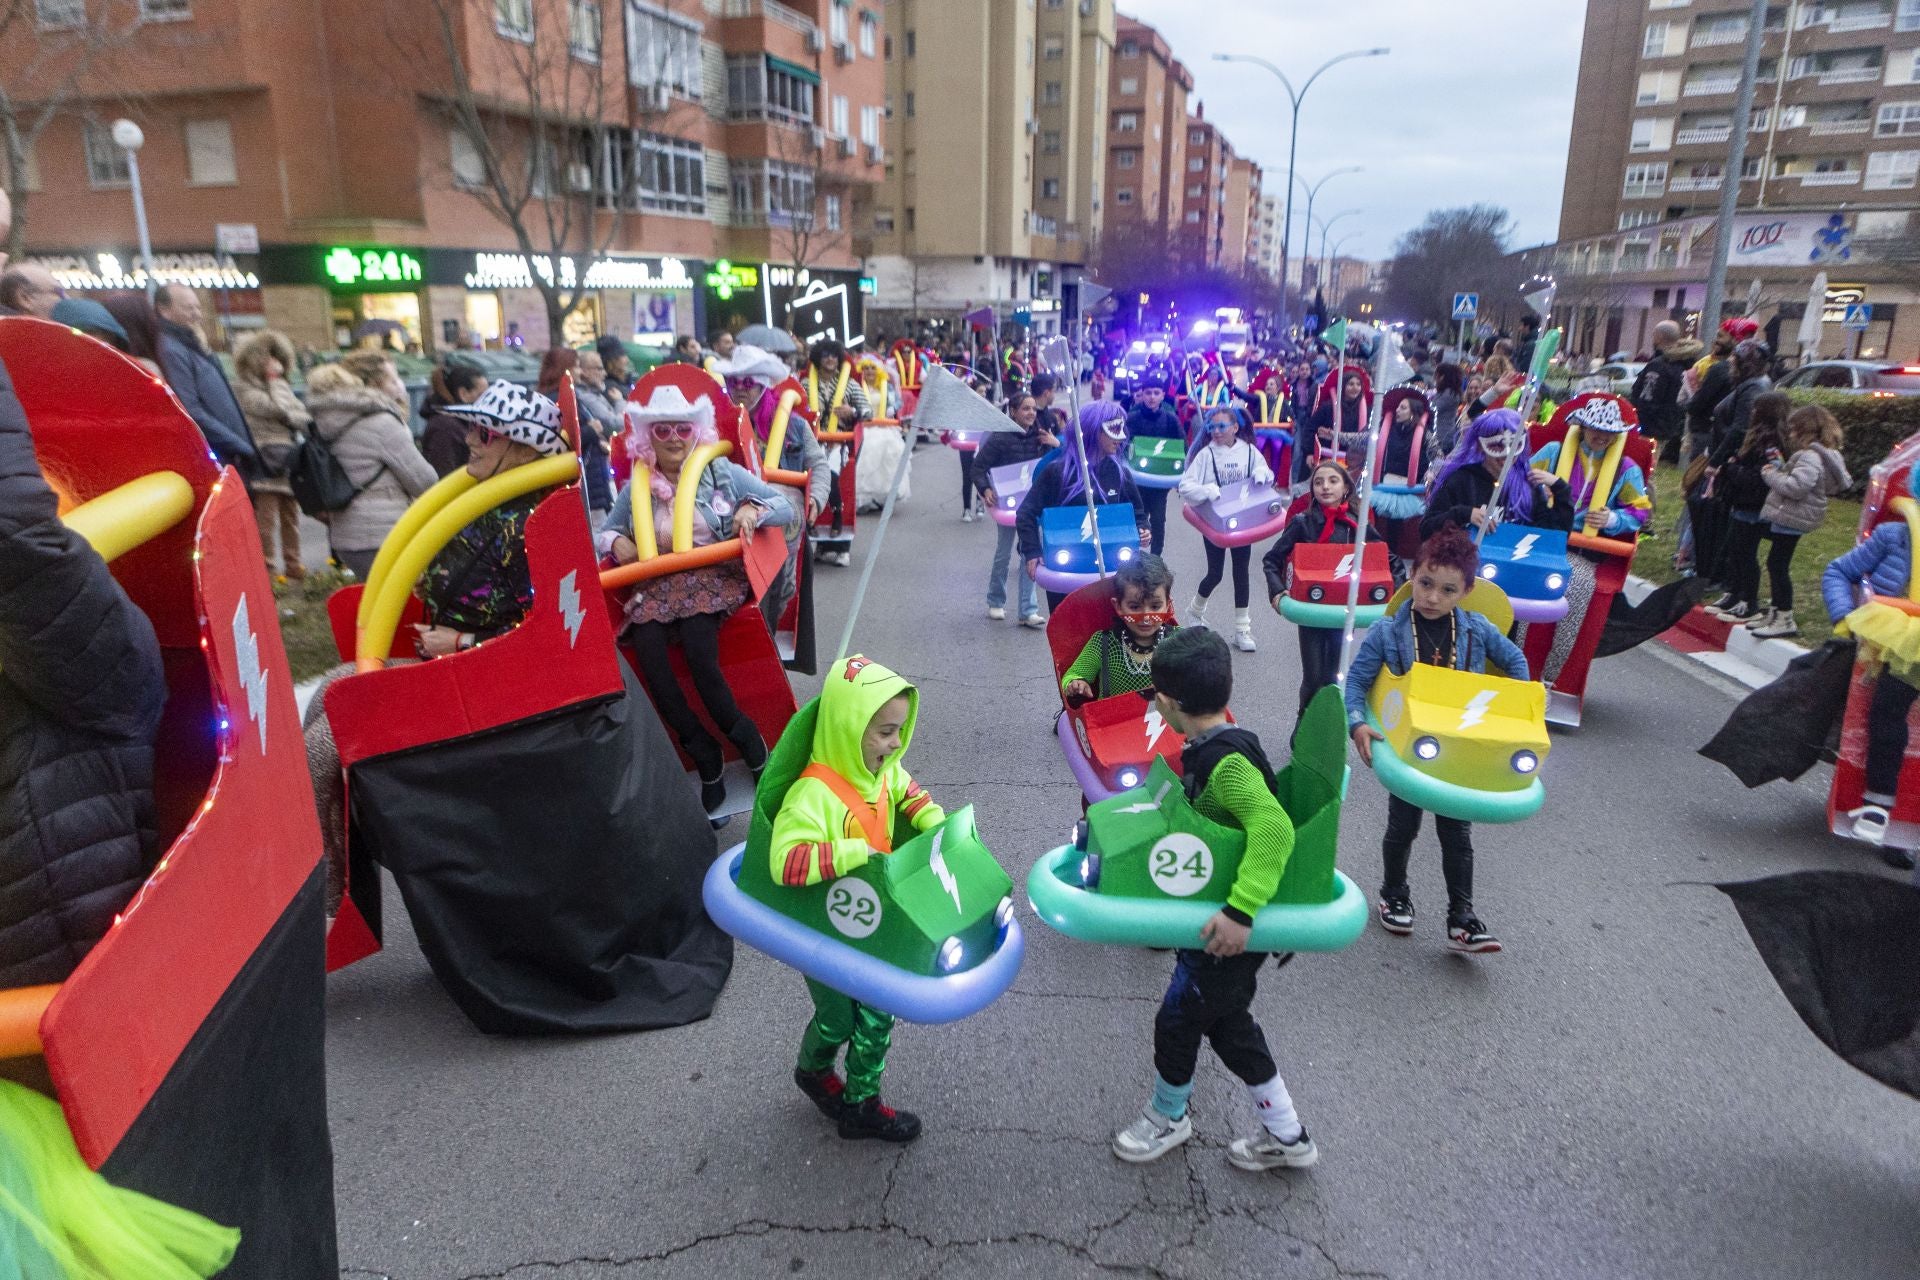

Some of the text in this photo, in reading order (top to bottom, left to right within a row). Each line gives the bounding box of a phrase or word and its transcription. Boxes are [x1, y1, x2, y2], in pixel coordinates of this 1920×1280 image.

[1741, 220, 1787, 249] 100
[361, 250, 422, 280] 24h
[1155, 849, 1207, 878] 24
[830, 888, 876, 927] 22
